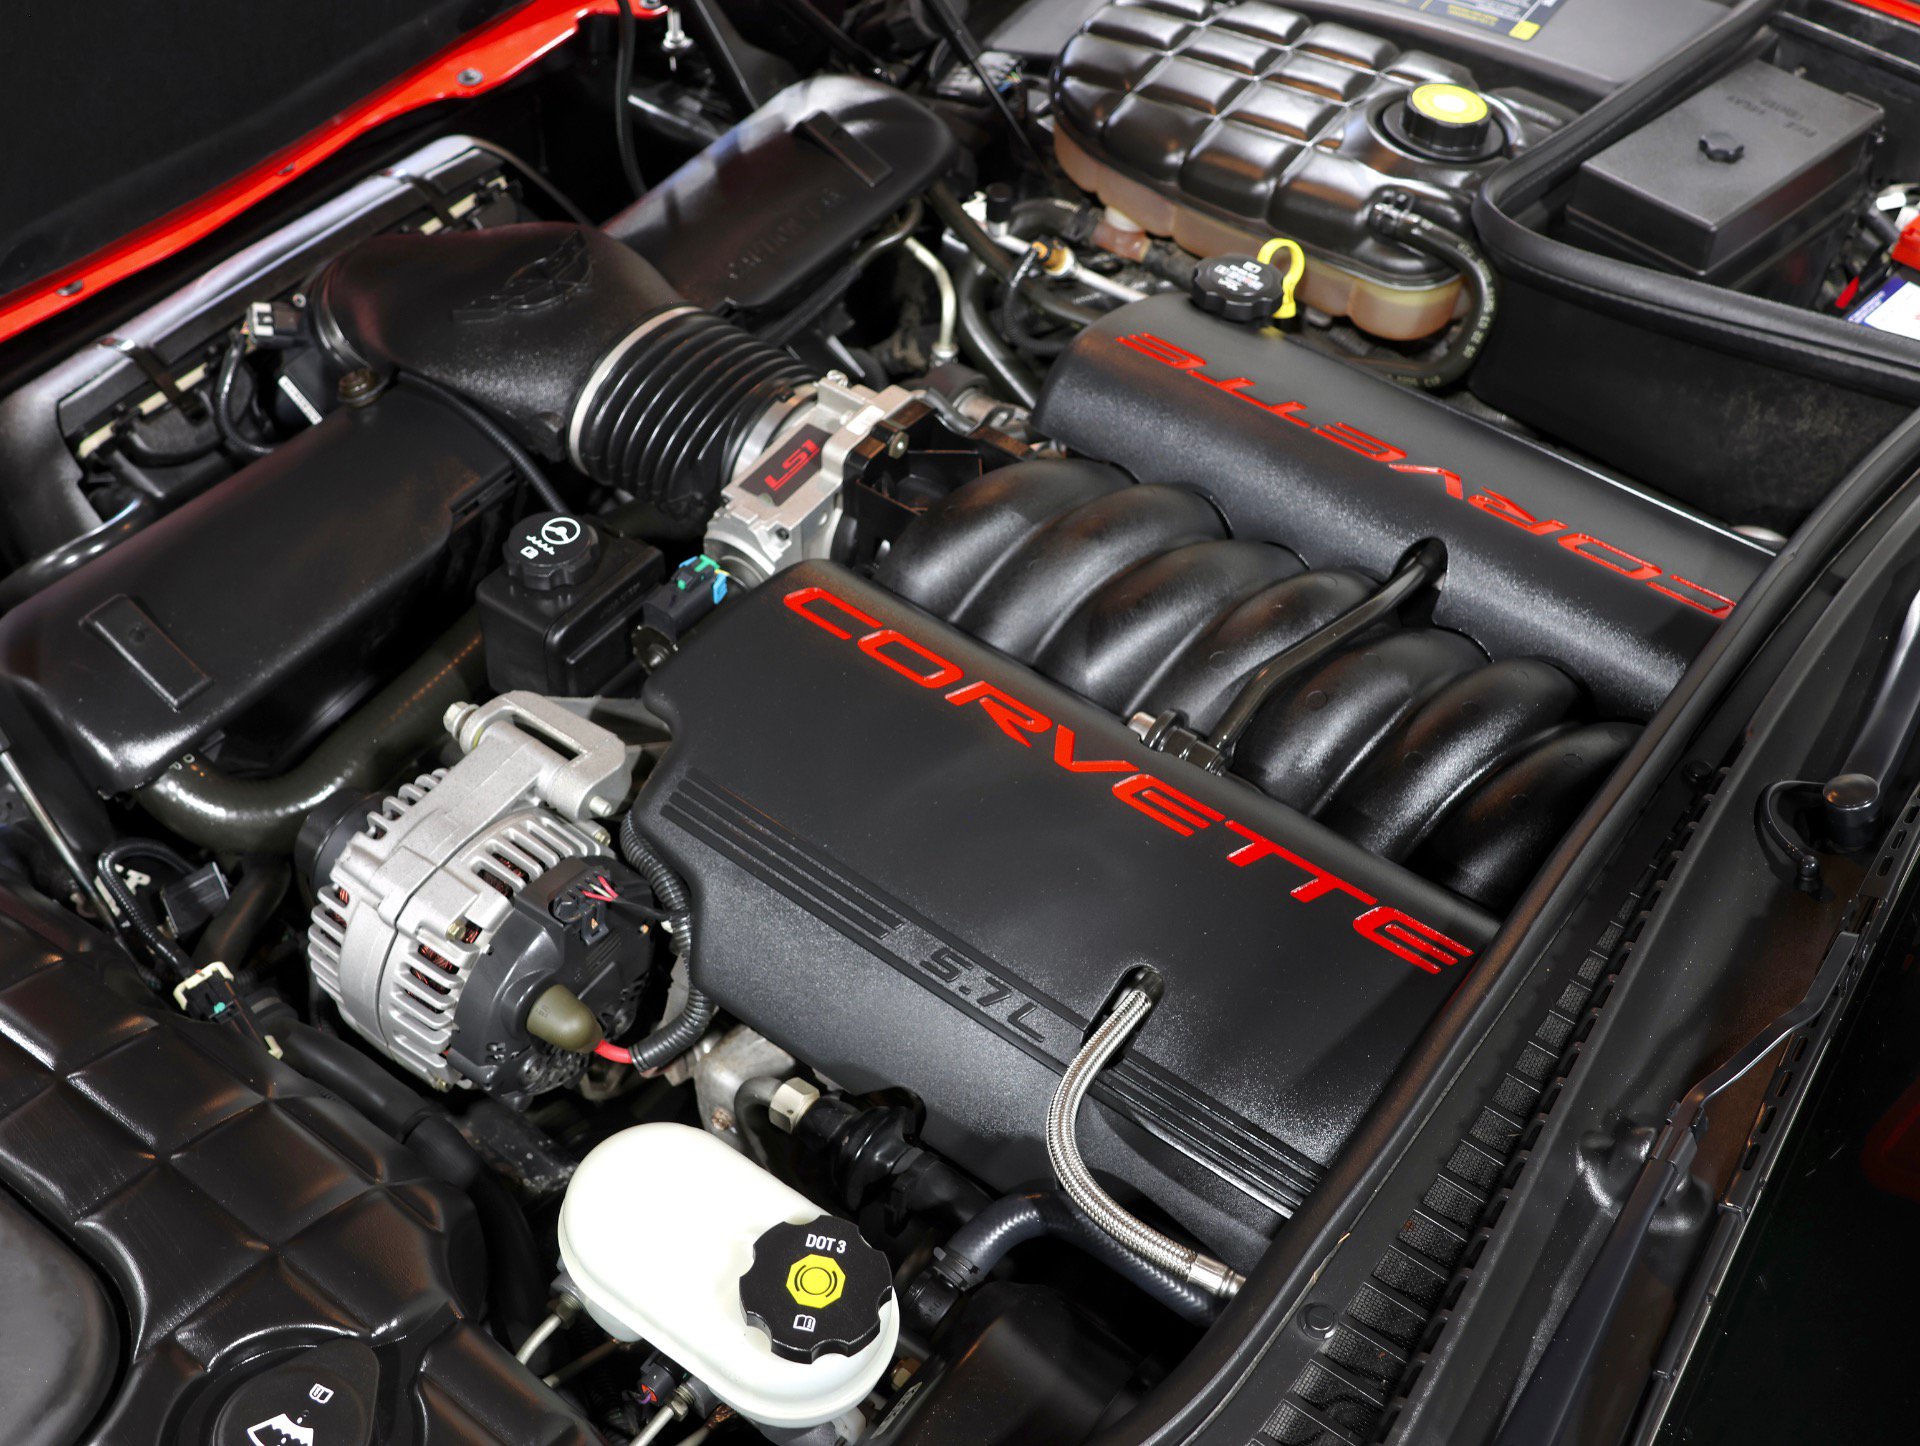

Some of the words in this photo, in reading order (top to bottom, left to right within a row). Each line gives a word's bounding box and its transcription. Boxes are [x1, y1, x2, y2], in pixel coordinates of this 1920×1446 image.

[764, 439, 820, 492] LS1
[1114, 331, 1737, 620] CORVETTE
[783, 585, 1475, 975] CORVETTE
[919, 947, 1046, 1043] 5.7L
[805, 1233, 836, 1251] DOT
[836, 1240, 847, 1254] 3
